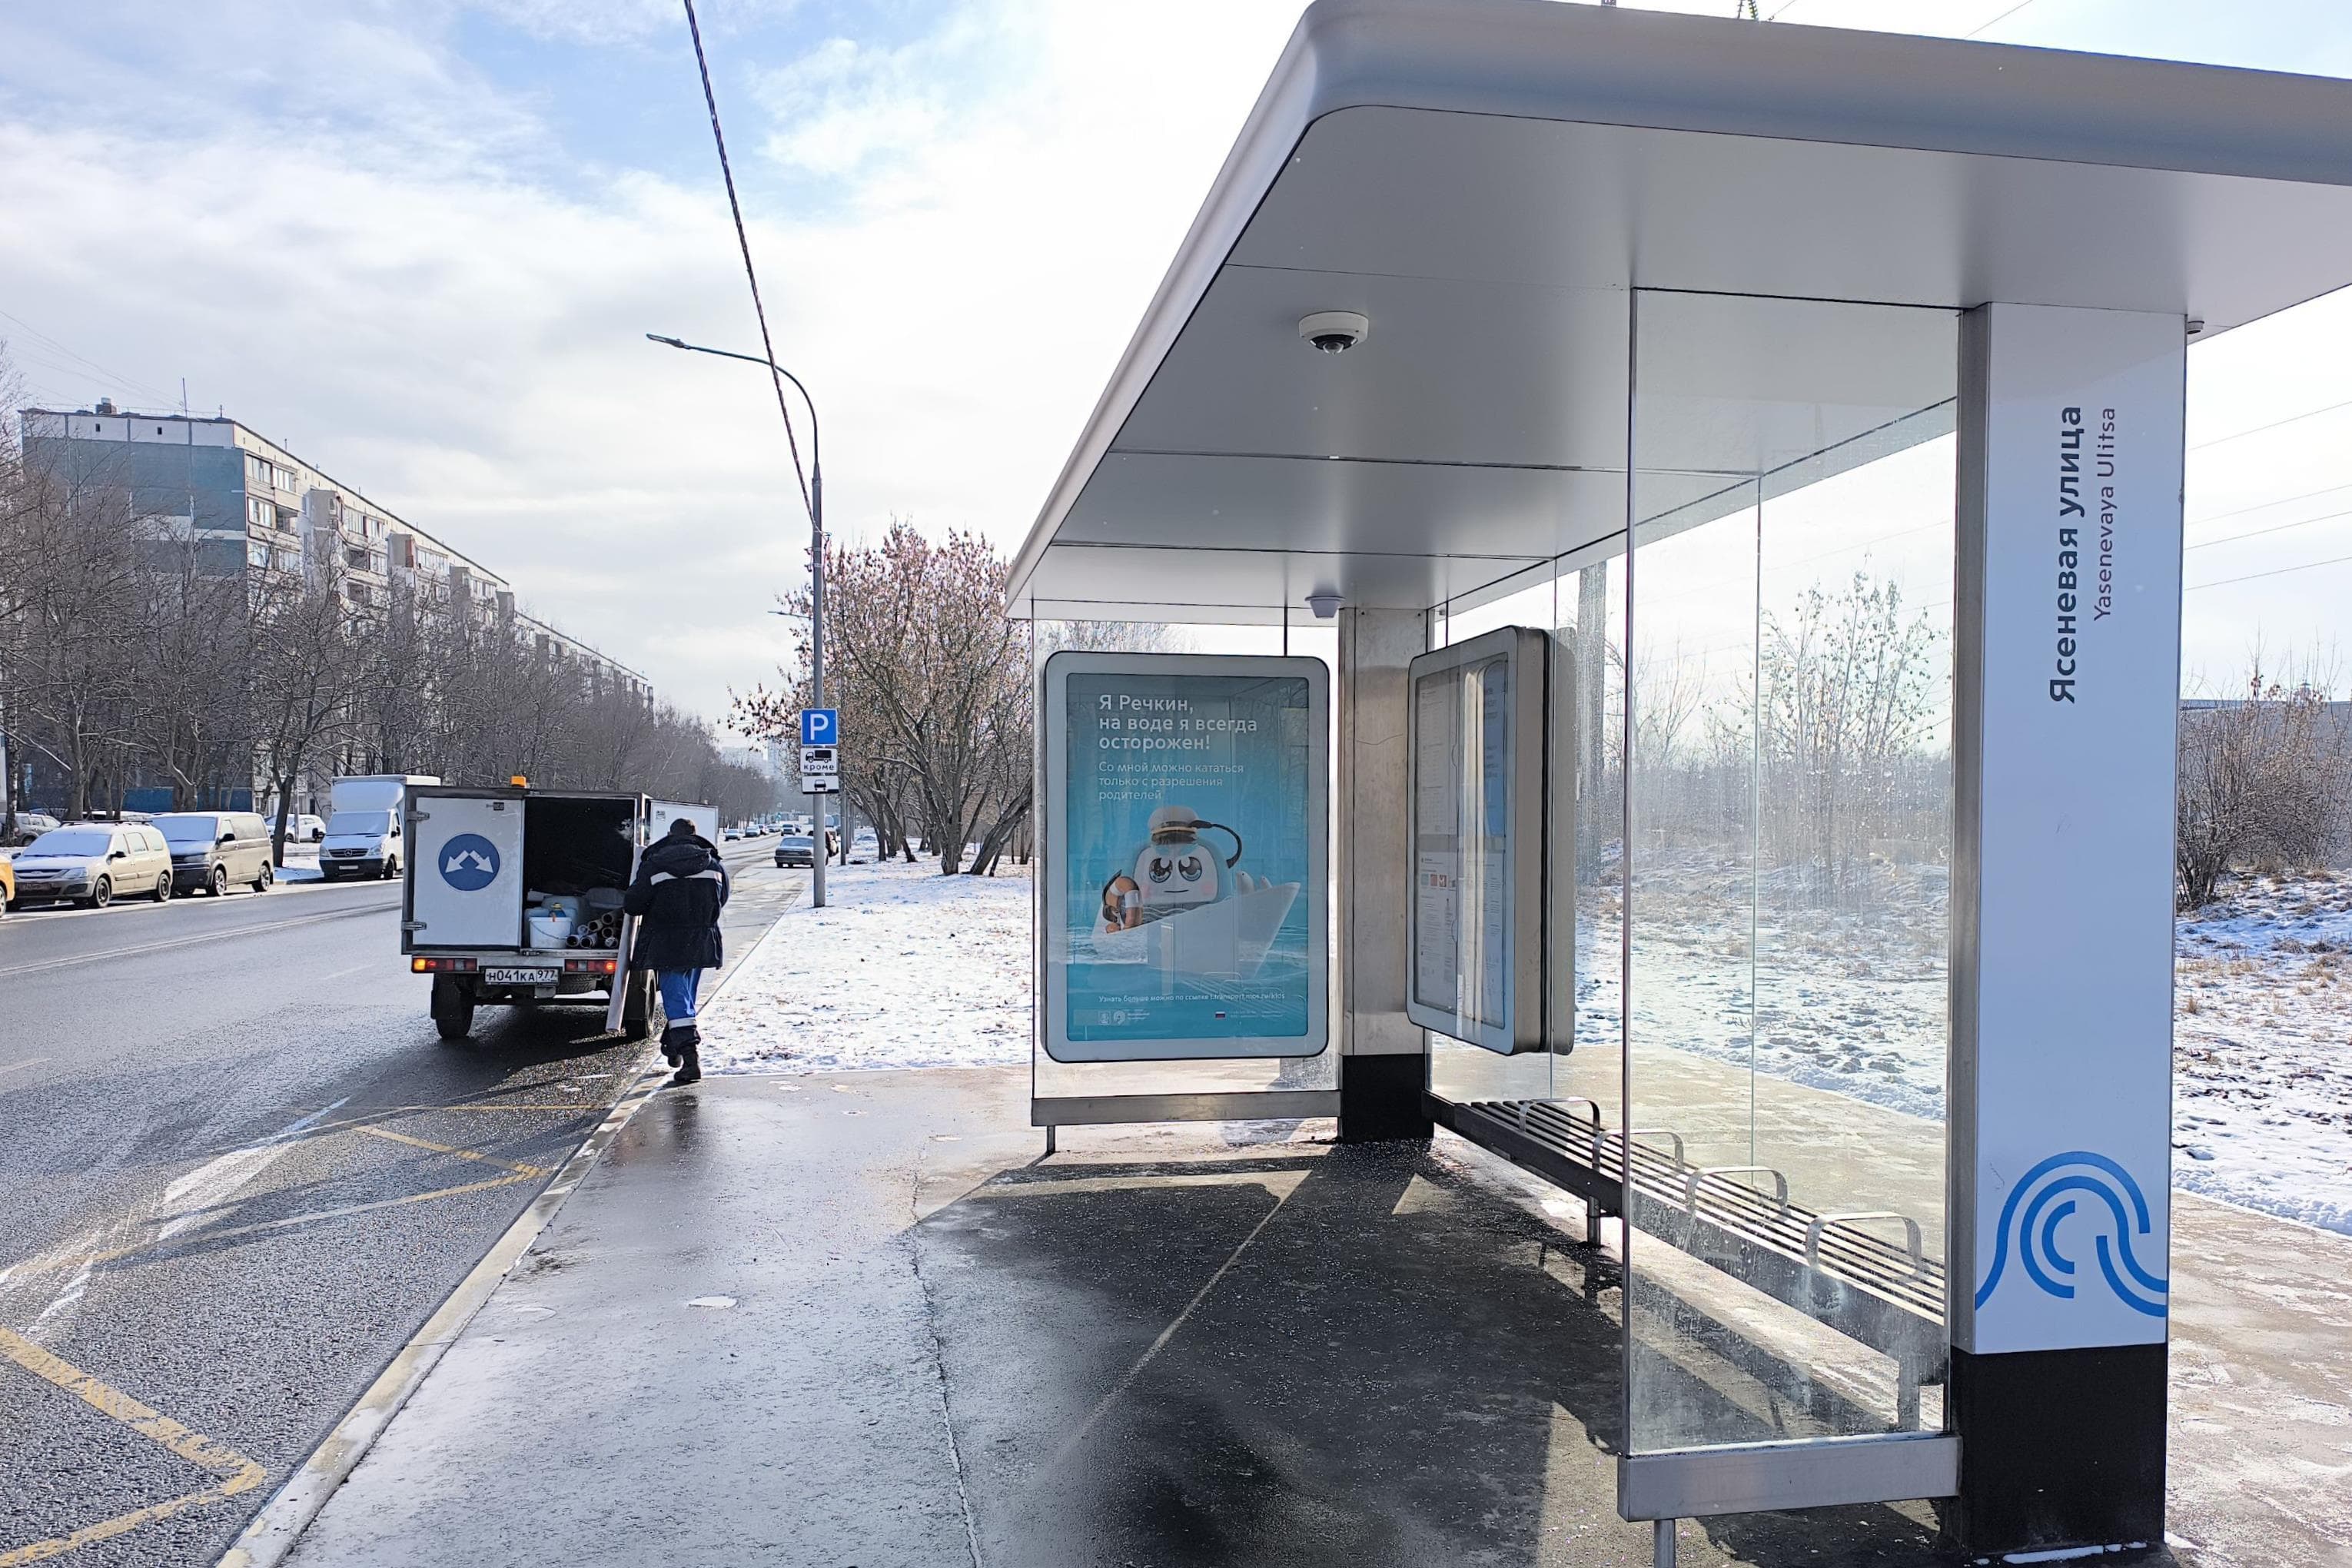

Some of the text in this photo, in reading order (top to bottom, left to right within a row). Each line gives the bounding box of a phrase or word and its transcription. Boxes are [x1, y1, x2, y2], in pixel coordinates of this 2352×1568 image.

[2094, 407, 2118, 621] Yasenevaya Ulitsa
[2049, 406, 2085, 703] Ясеневая улица
[1099, 694, 1194, 714] Я Речкин,
[810, 713, 829, 740] P
[1099, 717, 1257, 733] на воде я всегда
[1099, 735, 1211, 752] осторожен!
[1099, 761, 1244, 773] Со мной можно кататься
[1099, 777, 1138, 786] только
[1151, 778, 1223, 788] разрешения
[1099, 789, 1162, 801] родителей
[538, 970, 555, 978] 977
